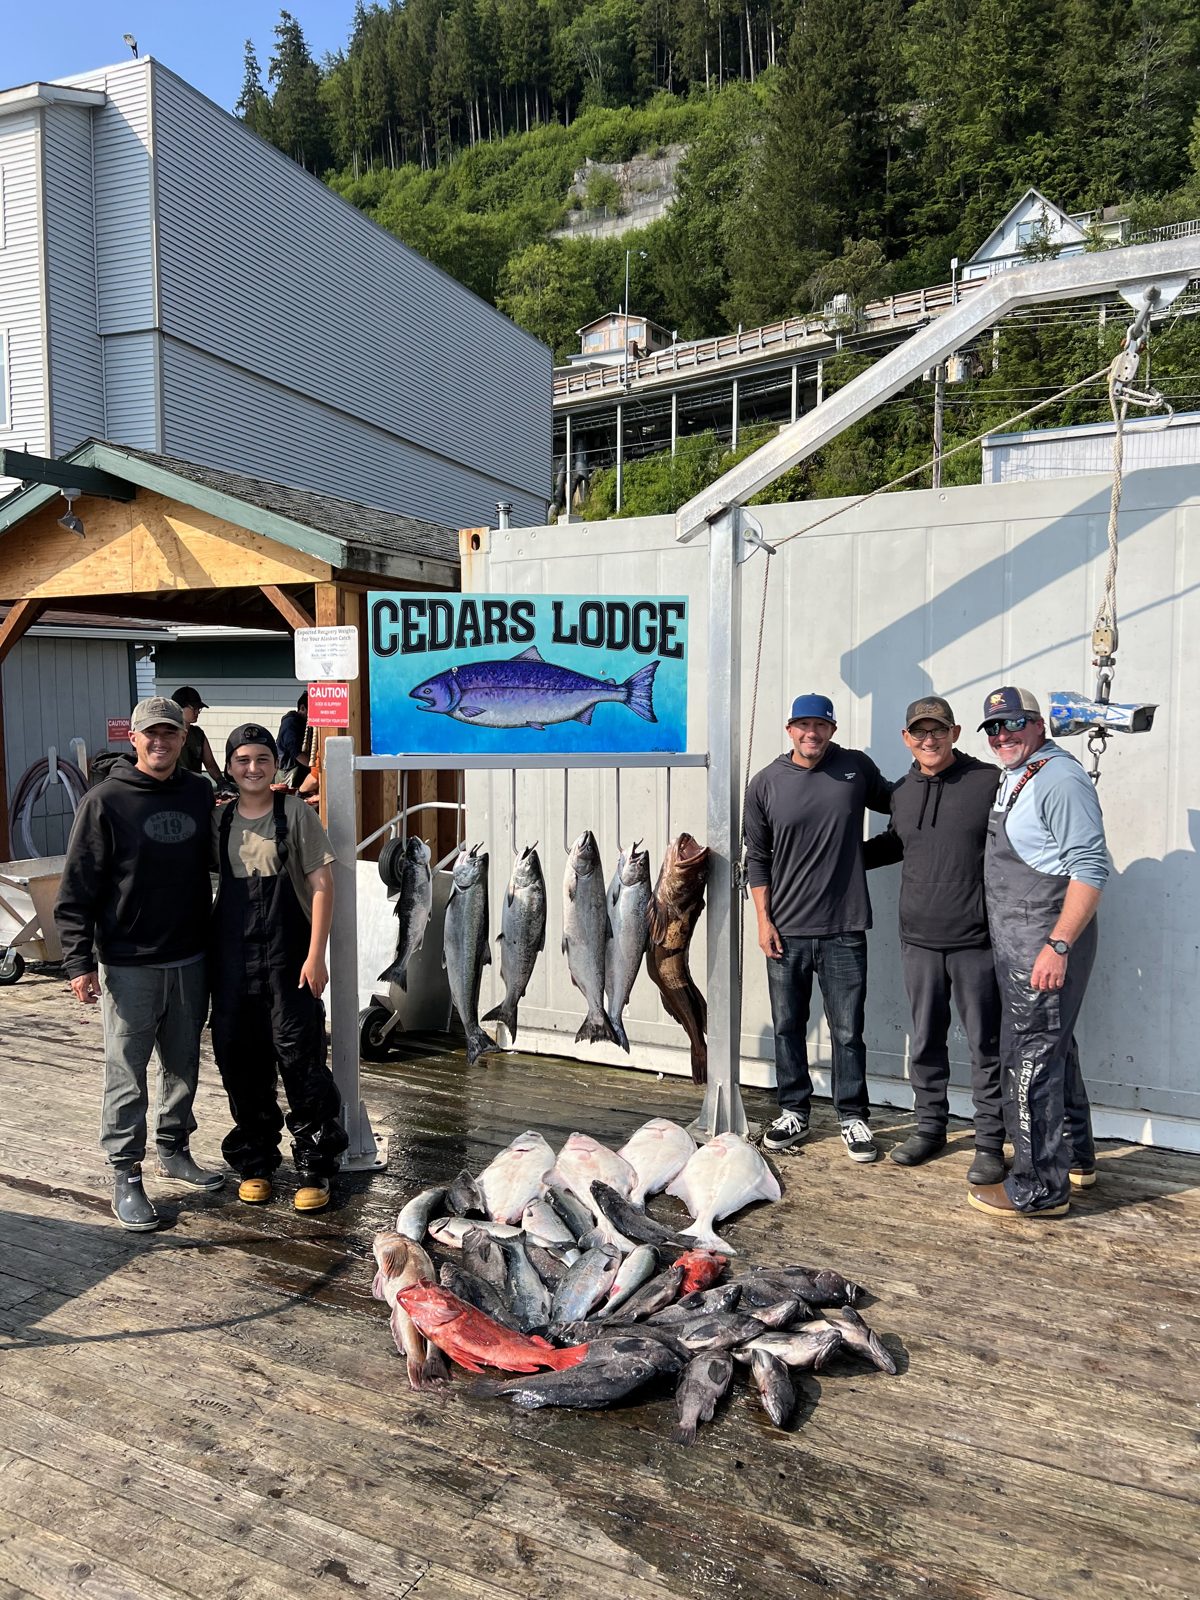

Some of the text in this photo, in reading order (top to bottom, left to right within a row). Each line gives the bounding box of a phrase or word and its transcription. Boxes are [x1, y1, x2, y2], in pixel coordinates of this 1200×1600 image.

[371, 598, 686, 660] CEDARS LODGE
[309, 687, 347, 698] CAUTION
[162, 818, 182, 834] 19
